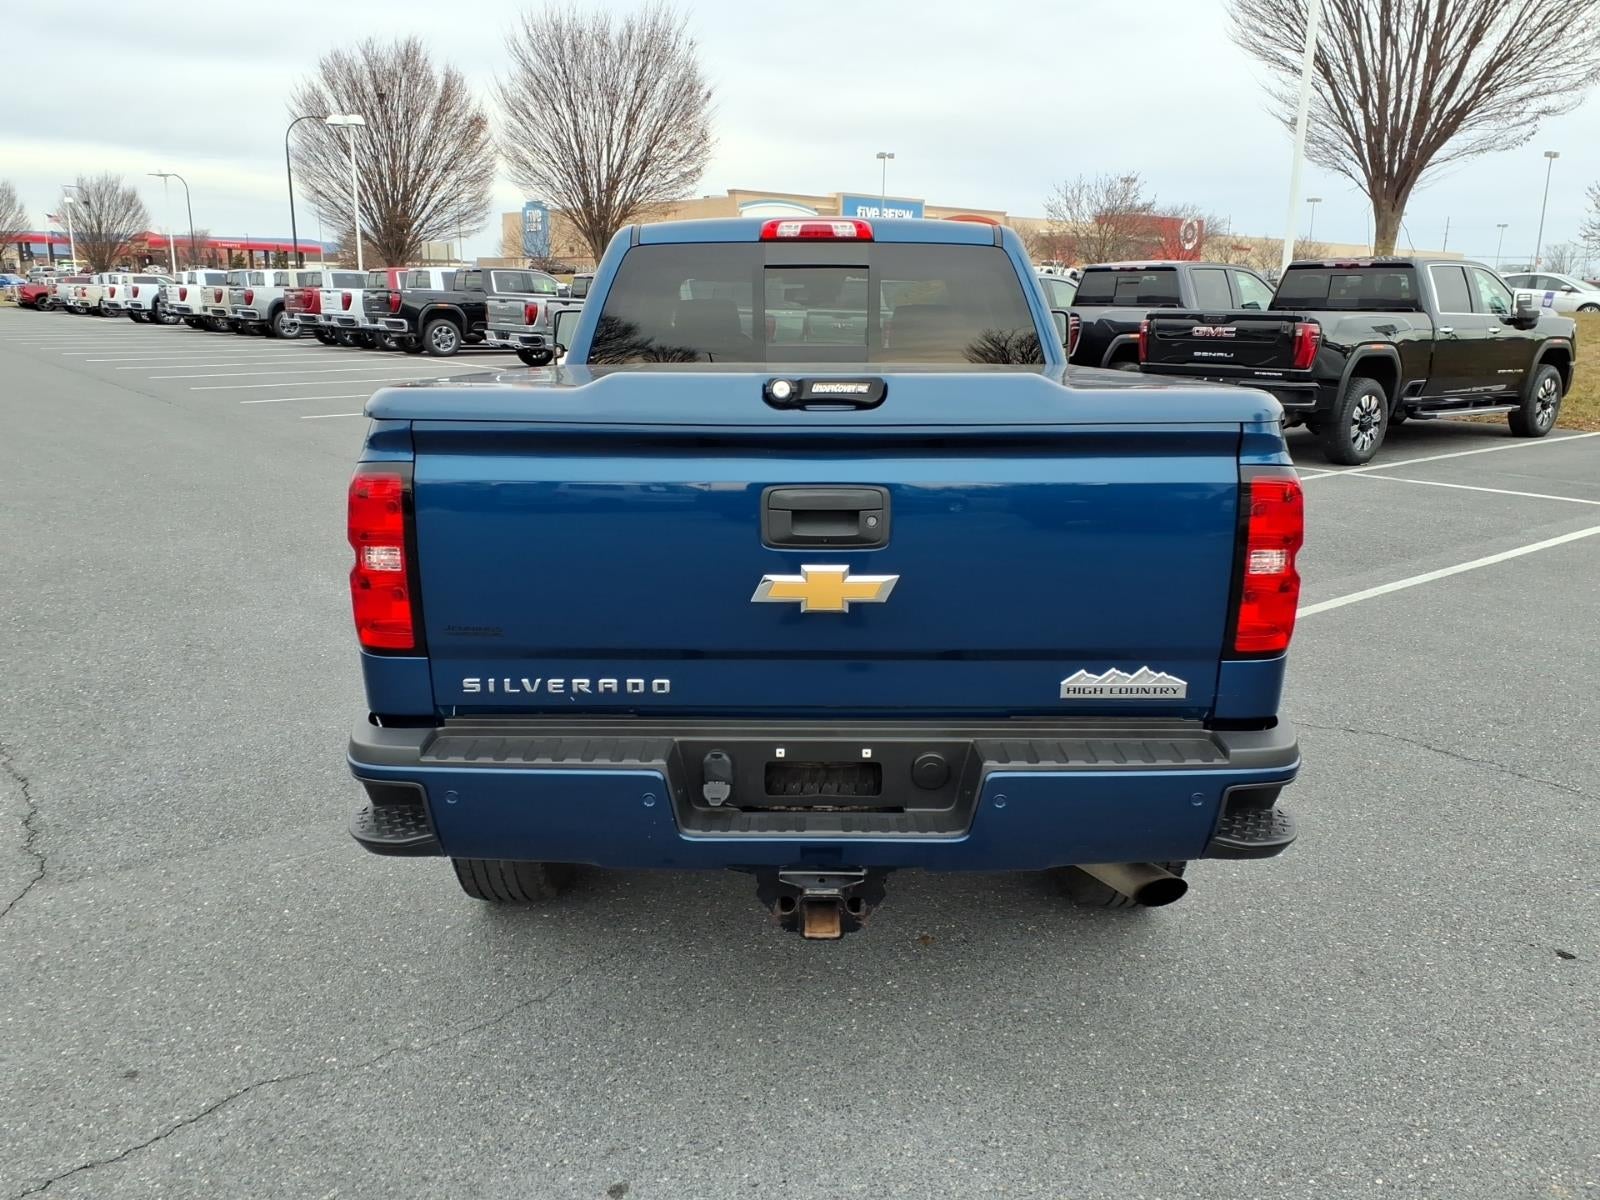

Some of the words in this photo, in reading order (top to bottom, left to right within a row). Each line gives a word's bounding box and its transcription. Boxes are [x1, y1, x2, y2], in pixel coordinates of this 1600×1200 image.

[1192, 326, 1237, 337] GMC
[462, 678, 671, 694] SILVERADO
[1066, 687, 1103, 695] HIGH
[1109, 687, 1180, 695] COUNTRY
